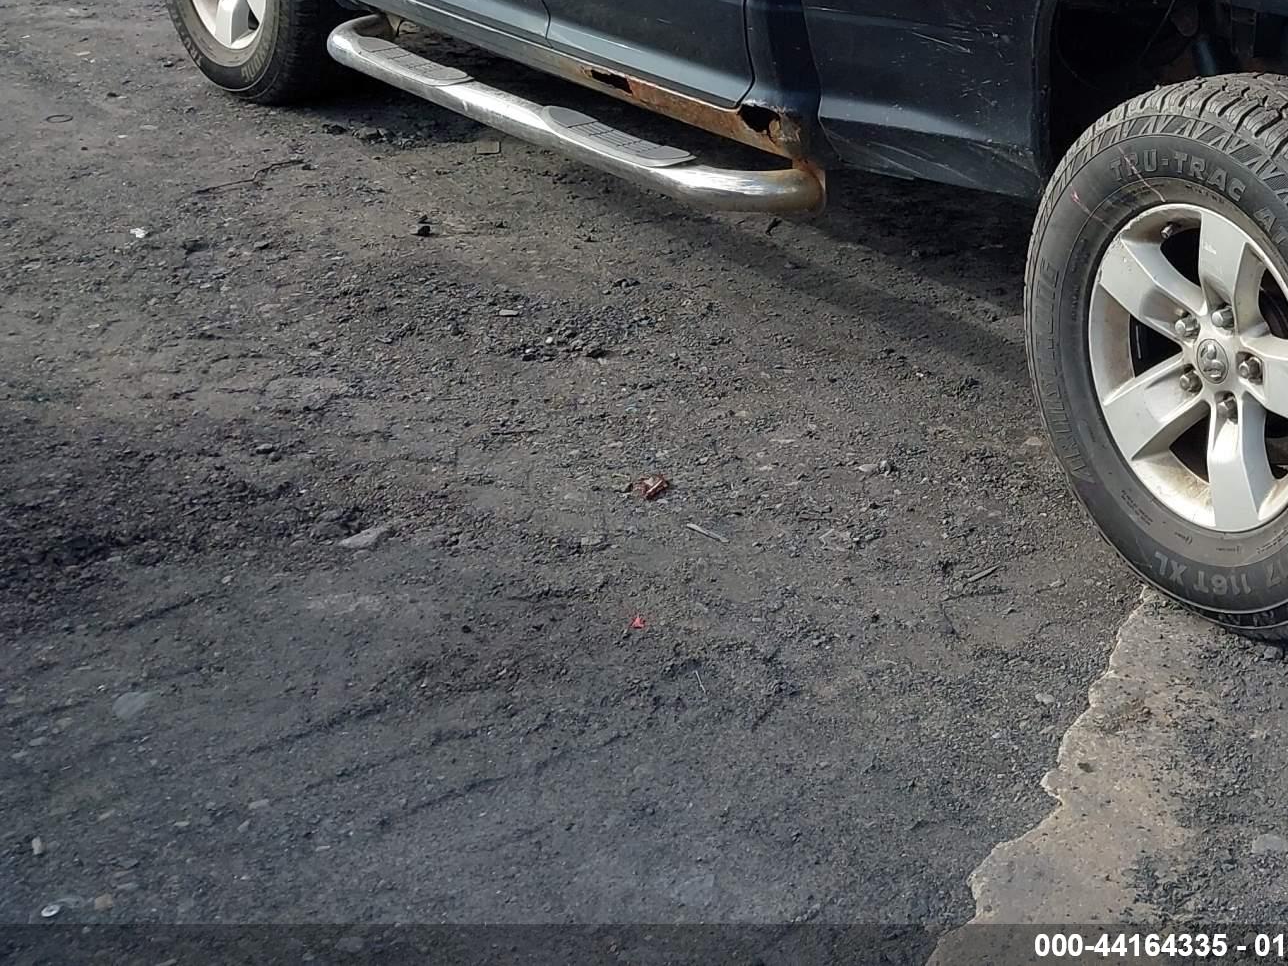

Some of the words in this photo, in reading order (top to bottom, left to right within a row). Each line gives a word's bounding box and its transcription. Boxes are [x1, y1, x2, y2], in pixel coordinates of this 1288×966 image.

[1109, 148, 1247, 202] TRU-TRAC
[1153, 550, 1188, 584] XL
[1193, 570, 1252, 596] 116T
